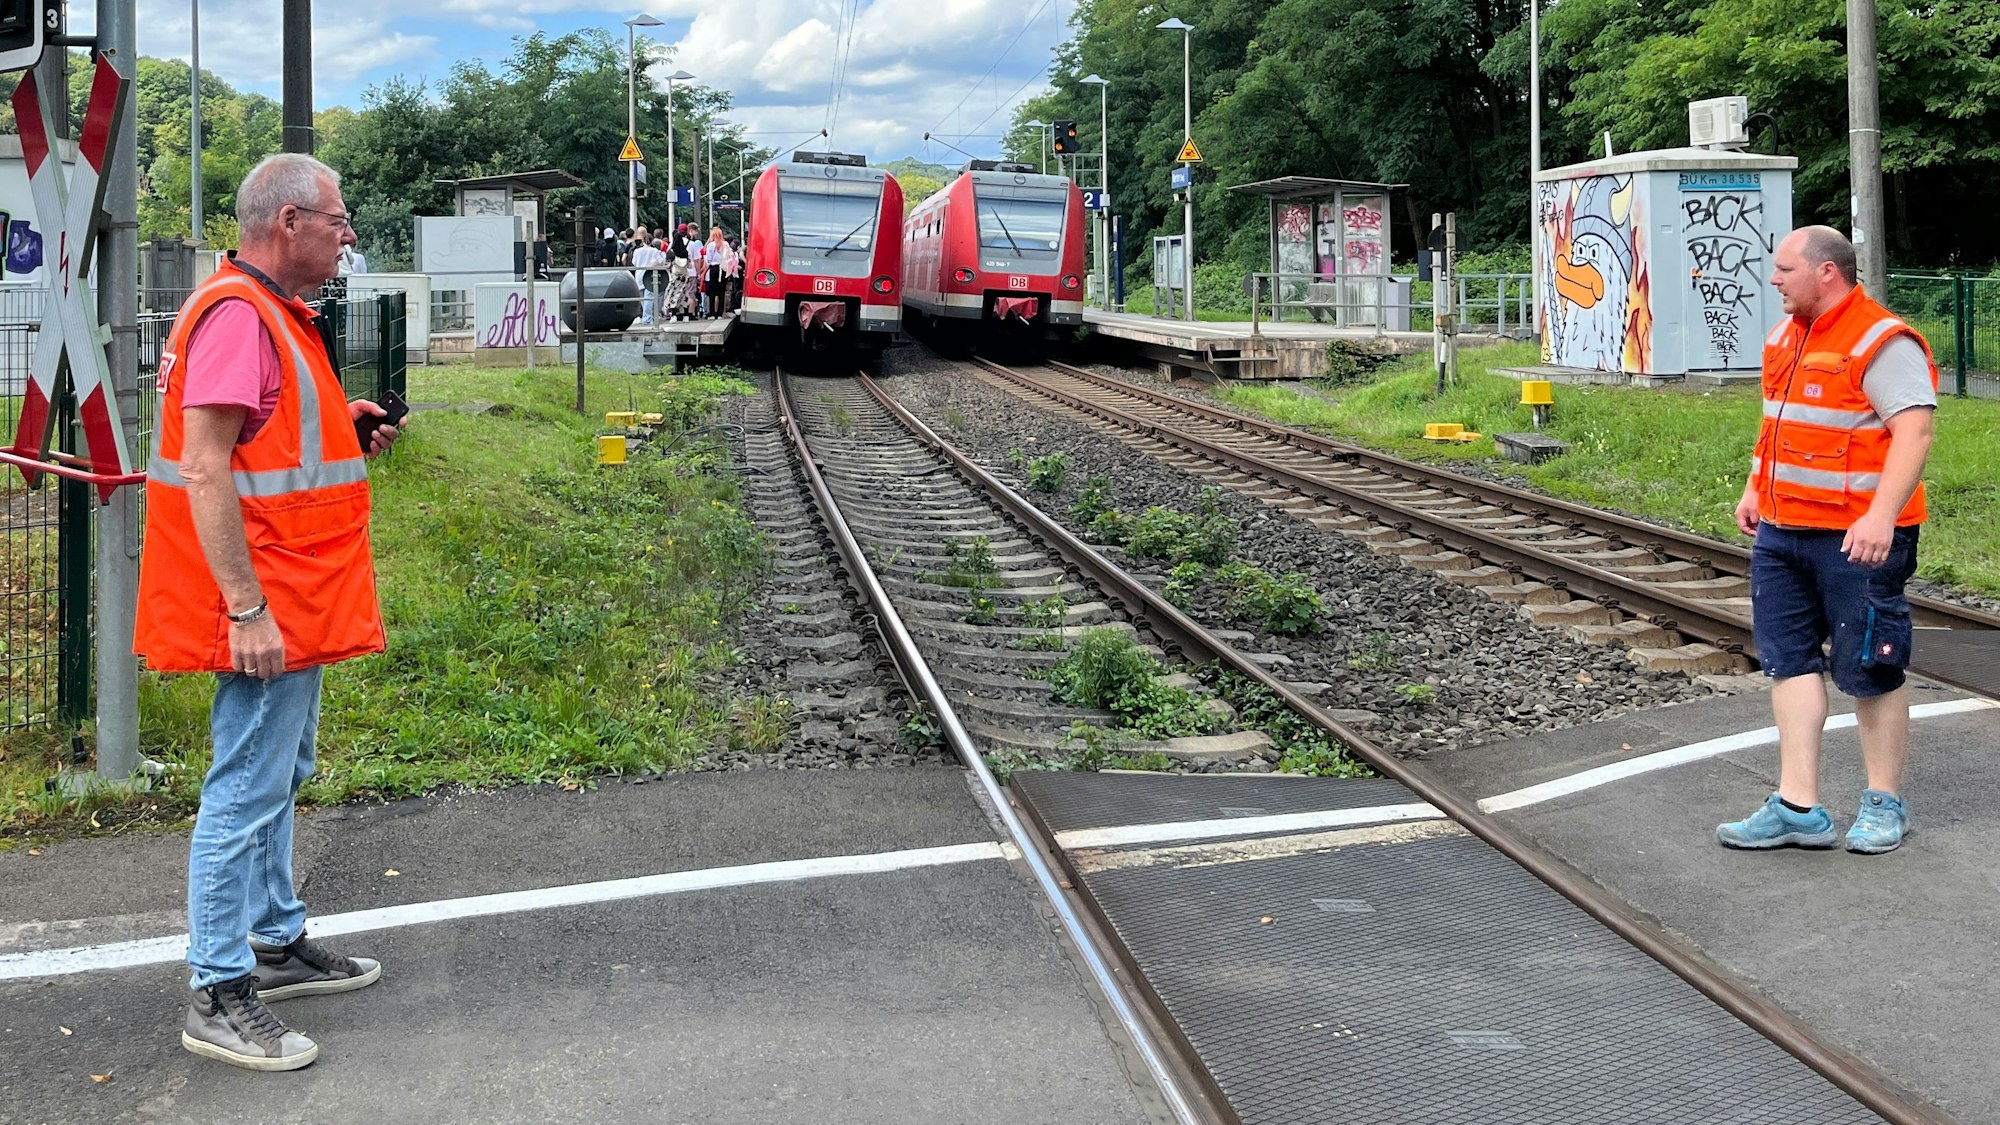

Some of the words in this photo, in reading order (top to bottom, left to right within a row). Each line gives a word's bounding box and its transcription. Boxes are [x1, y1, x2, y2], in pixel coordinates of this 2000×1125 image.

[46, 8, 58, 29] 3
[1721, 173, 1760, 185] 38,535
[687, 187, 695, 202] 1
[1083, 191, 1094, 208] 2
[1683, 194, 1774, 254] BACK
[1688, 238, 1762, 287] BACK
[816, 280, 833, 292] DB
[1011, 277, 1026, 288] DB
[1699, 282, 1755, 316] BACK
[1704, 311, 1739, 330] BACK
[1711, 328, 1739, 343] BACK
[1716, 342, 1738, 354] BACK
[1806, 386, 1819, 396] DB
